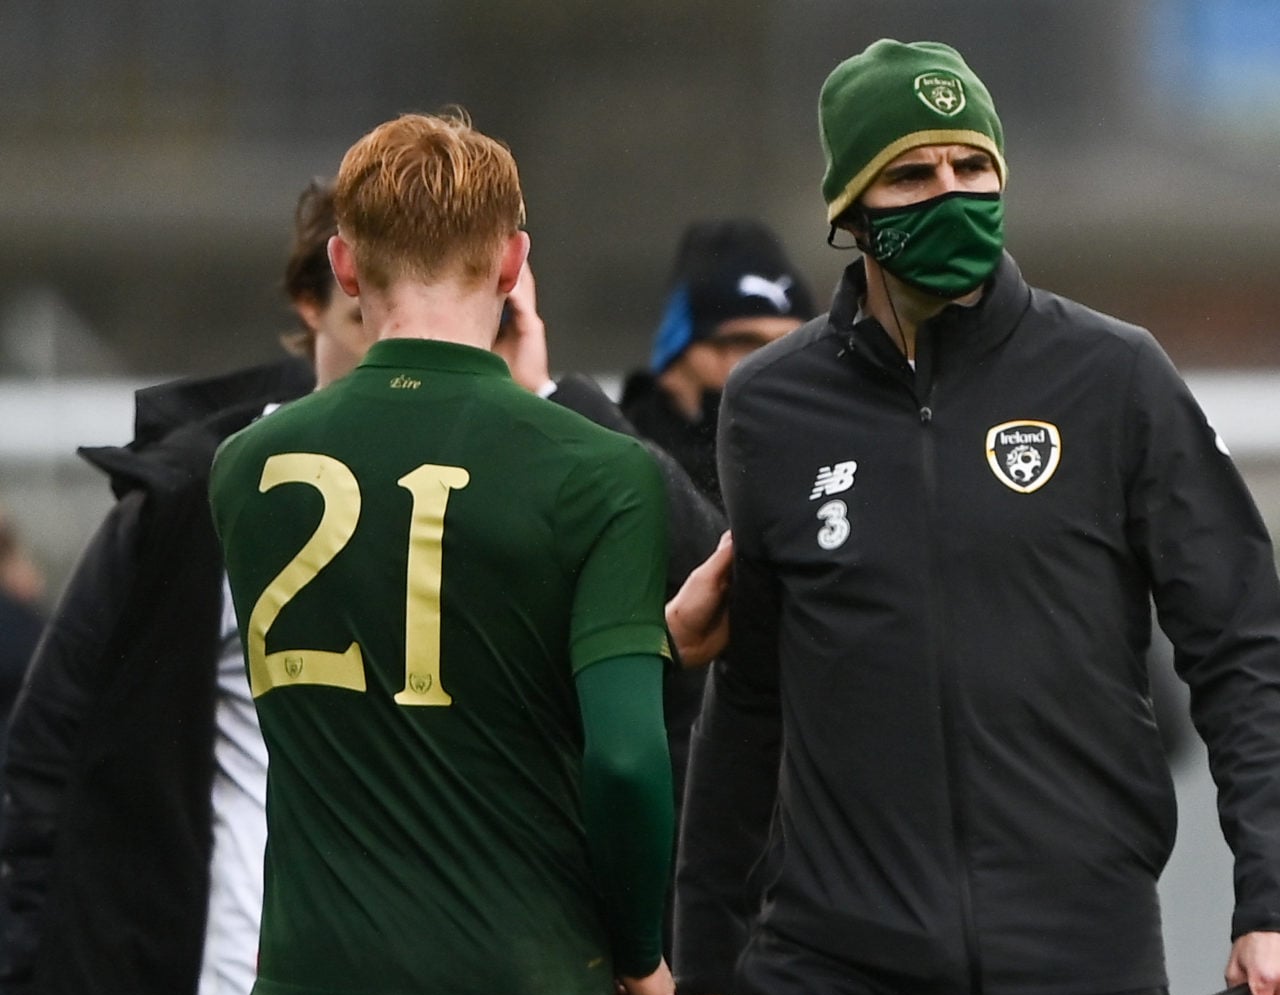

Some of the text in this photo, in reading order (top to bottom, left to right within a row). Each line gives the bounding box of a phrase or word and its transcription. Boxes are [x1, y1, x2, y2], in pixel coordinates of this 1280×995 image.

[390, 374, 421, 389] Éire
[1000, 429, 1045, 446] Ireland
[817, 499, 851, 550] 3
[248, 452, 467, 706] 21
